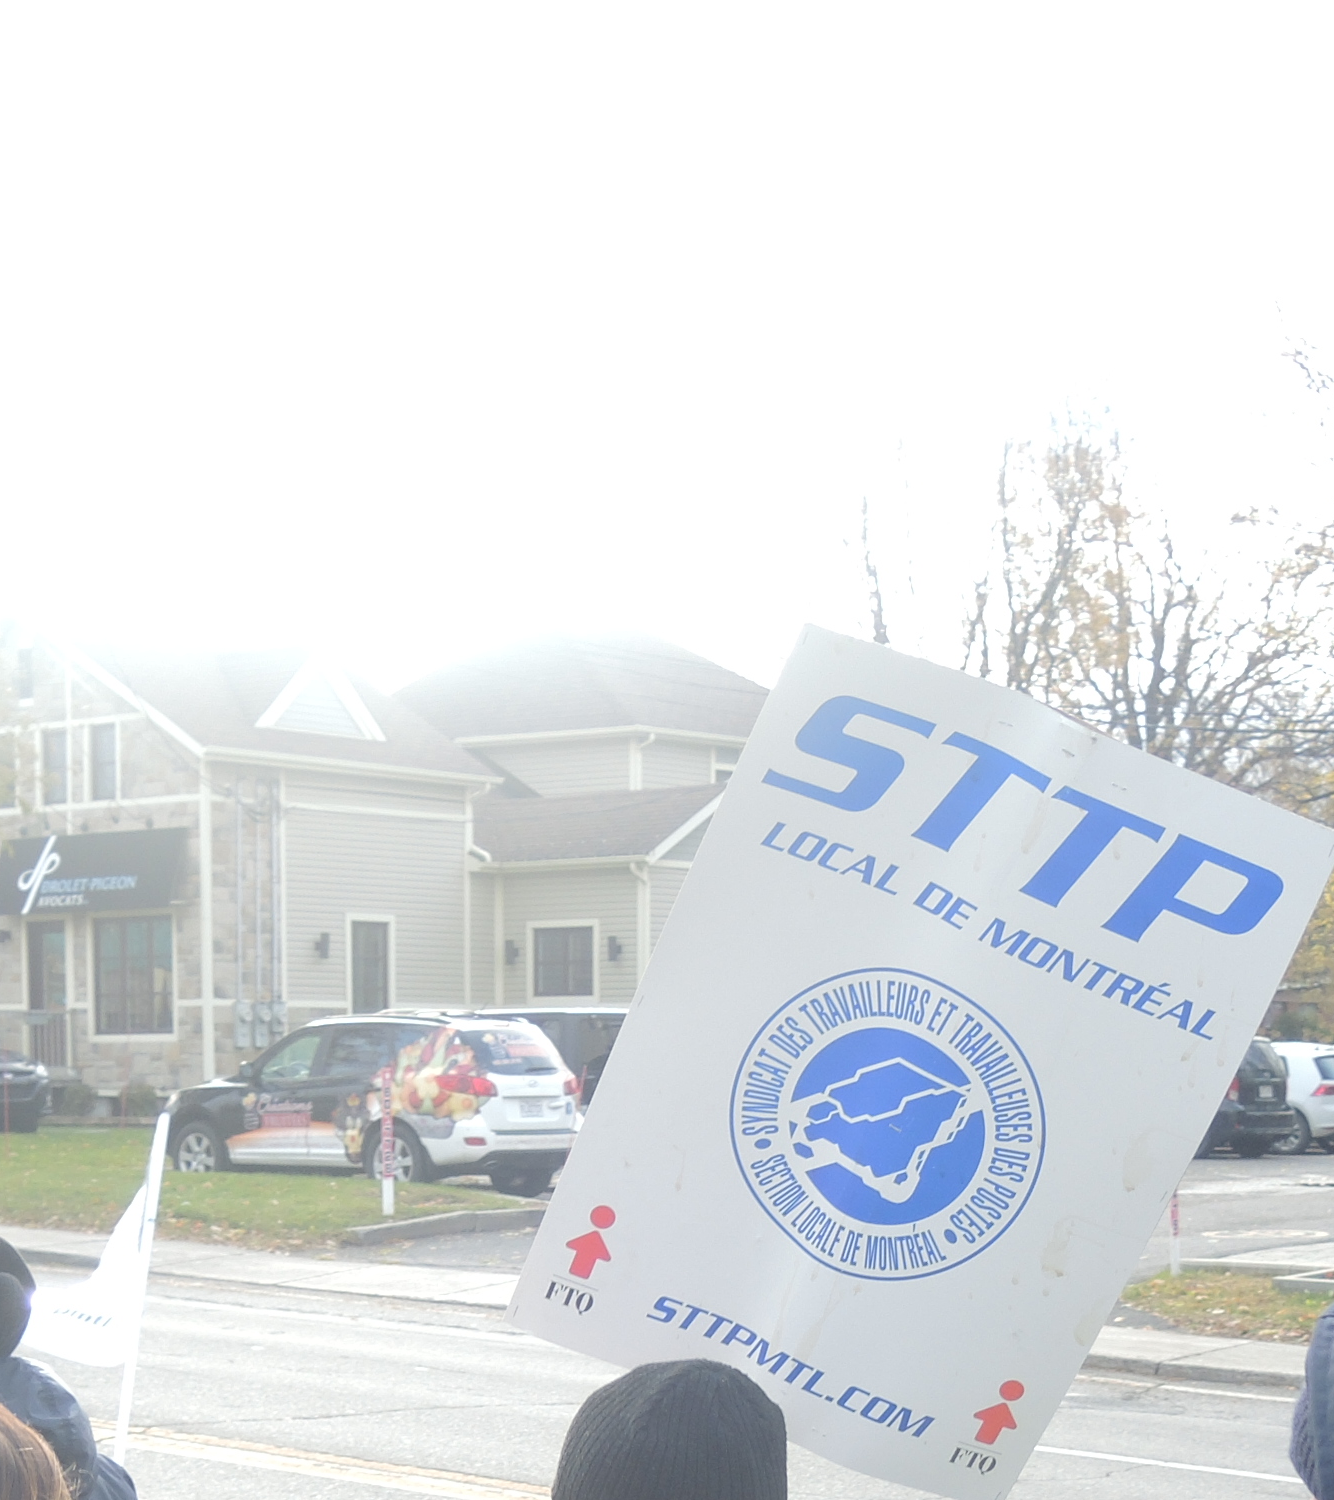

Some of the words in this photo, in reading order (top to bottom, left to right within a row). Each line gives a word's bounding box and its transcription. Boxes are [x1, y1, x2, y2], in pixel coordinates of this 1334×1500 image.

[760, 694, 1285, 944] STTP
[760, 821, 900, 896] LOCAL
[912, 880, 979, 931] DE
[977, 916, 1216, 1041] MONTRÉAL
[768, 1015, 814, 1060] DES
[798, 979, 932, 1036] TRAVAILLEURS
[926, 996, 959, 1036] ET
[741, 1046, 793, 1137] SYNDICAT
[948, 1012, 1033, 1143] TRAVAILLEUSES
[987, 1146, 1031, 1185] DES
[750, 1152, 809, 1218] SECTION
[790, 1205, 846, 1258] LOCALE
[839, 1227, 864, 1267] DE
[863, 1223, 948, 1272] MONTRÉAL
[955, 1176, 1017, 1245] POSTES
[544, 1279, 595, 1315] FTQ
[646, 1295, 935, 1439] STTPMTL.COM
[948, 1445, 997, 1475] FTQ
